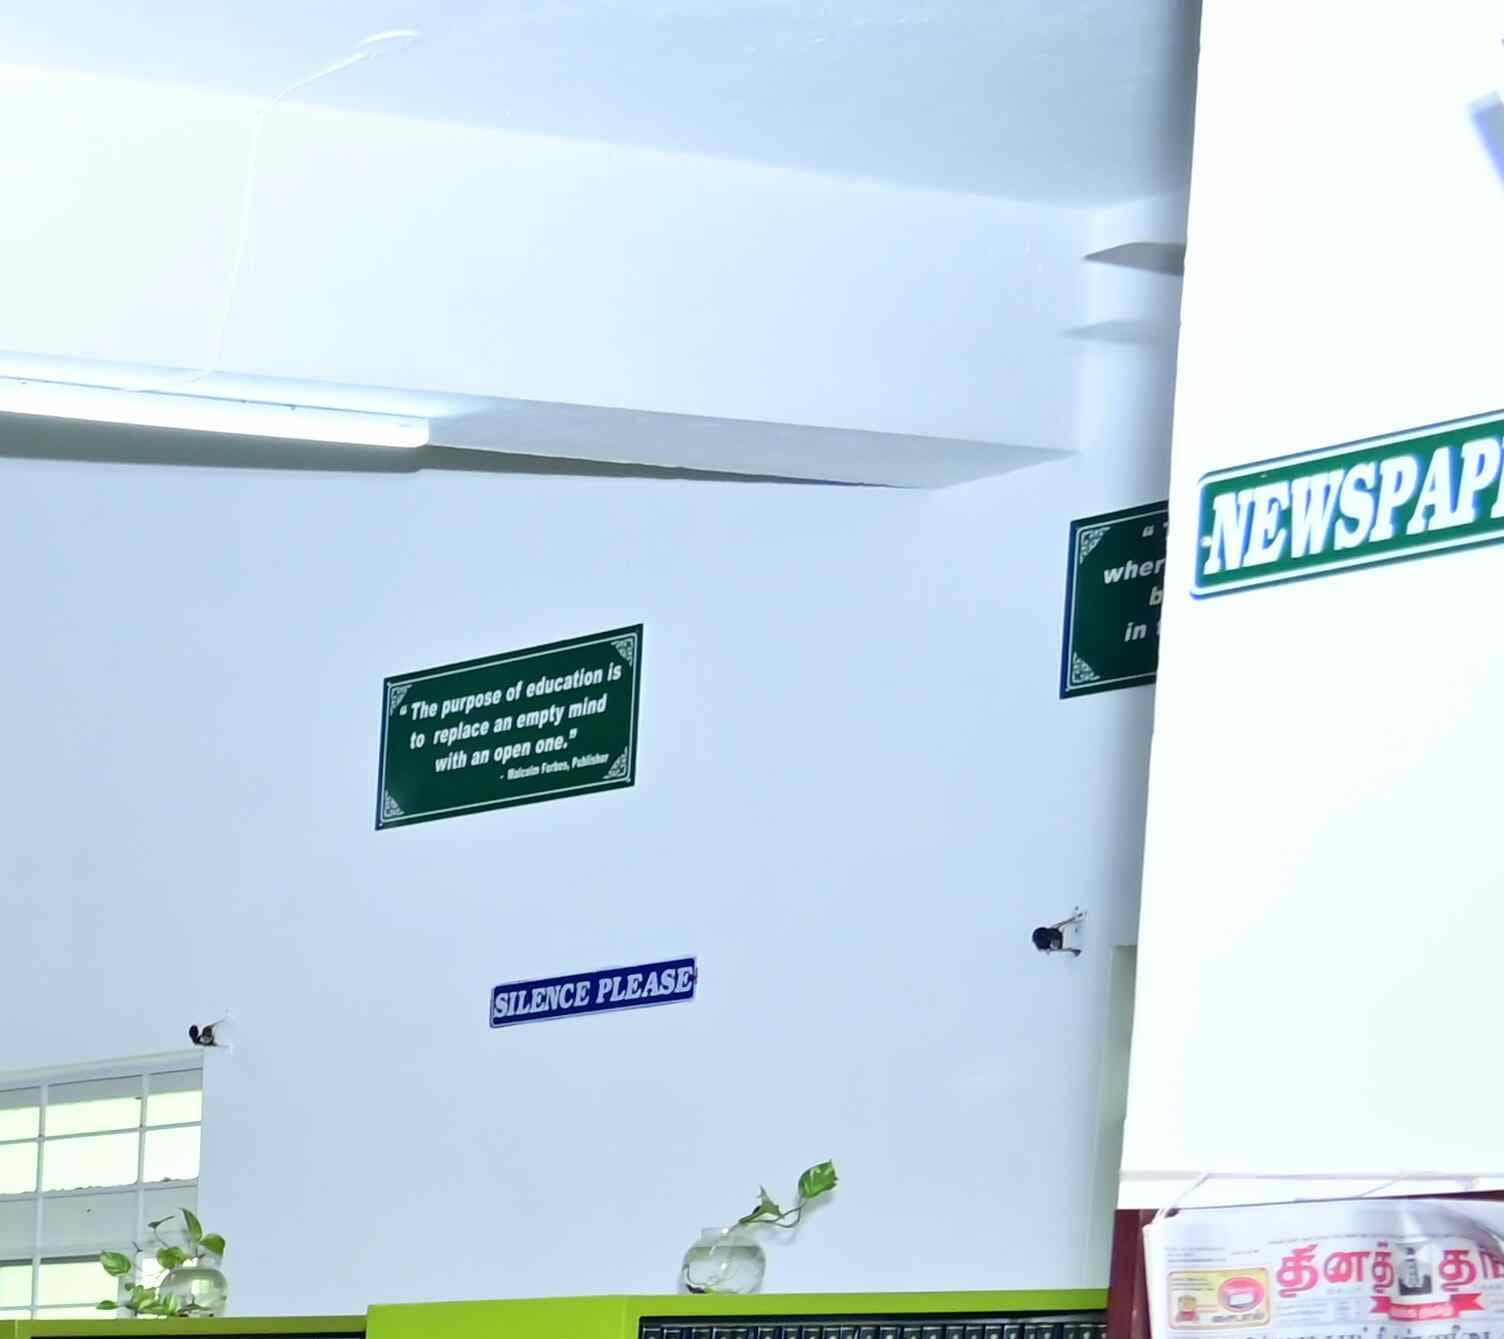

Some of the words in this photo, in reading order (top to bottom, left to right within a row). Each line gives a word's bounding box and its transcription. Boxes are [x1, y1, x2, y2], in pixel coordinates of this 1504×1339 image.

[441, 689, 502, 719] purpose
[506, 680, 523, 702] of
[526, 667, 603, 699] education
[607, 661, 623, 682] is
[410, 730, 425, 749] to
[433, 720, 490, 747] replace
[493, 715, 512, 733] an
[516, 706, 564, 733] empty
[568, 693, 608, 719] mind
[435, 749, 467, 773] with
[470, 748, 489, 767] an
[494, 740, 531, 765] open
[493, 980, 592, 1019] SILENCE
[596, 965, 694, 1005] PLEASE
